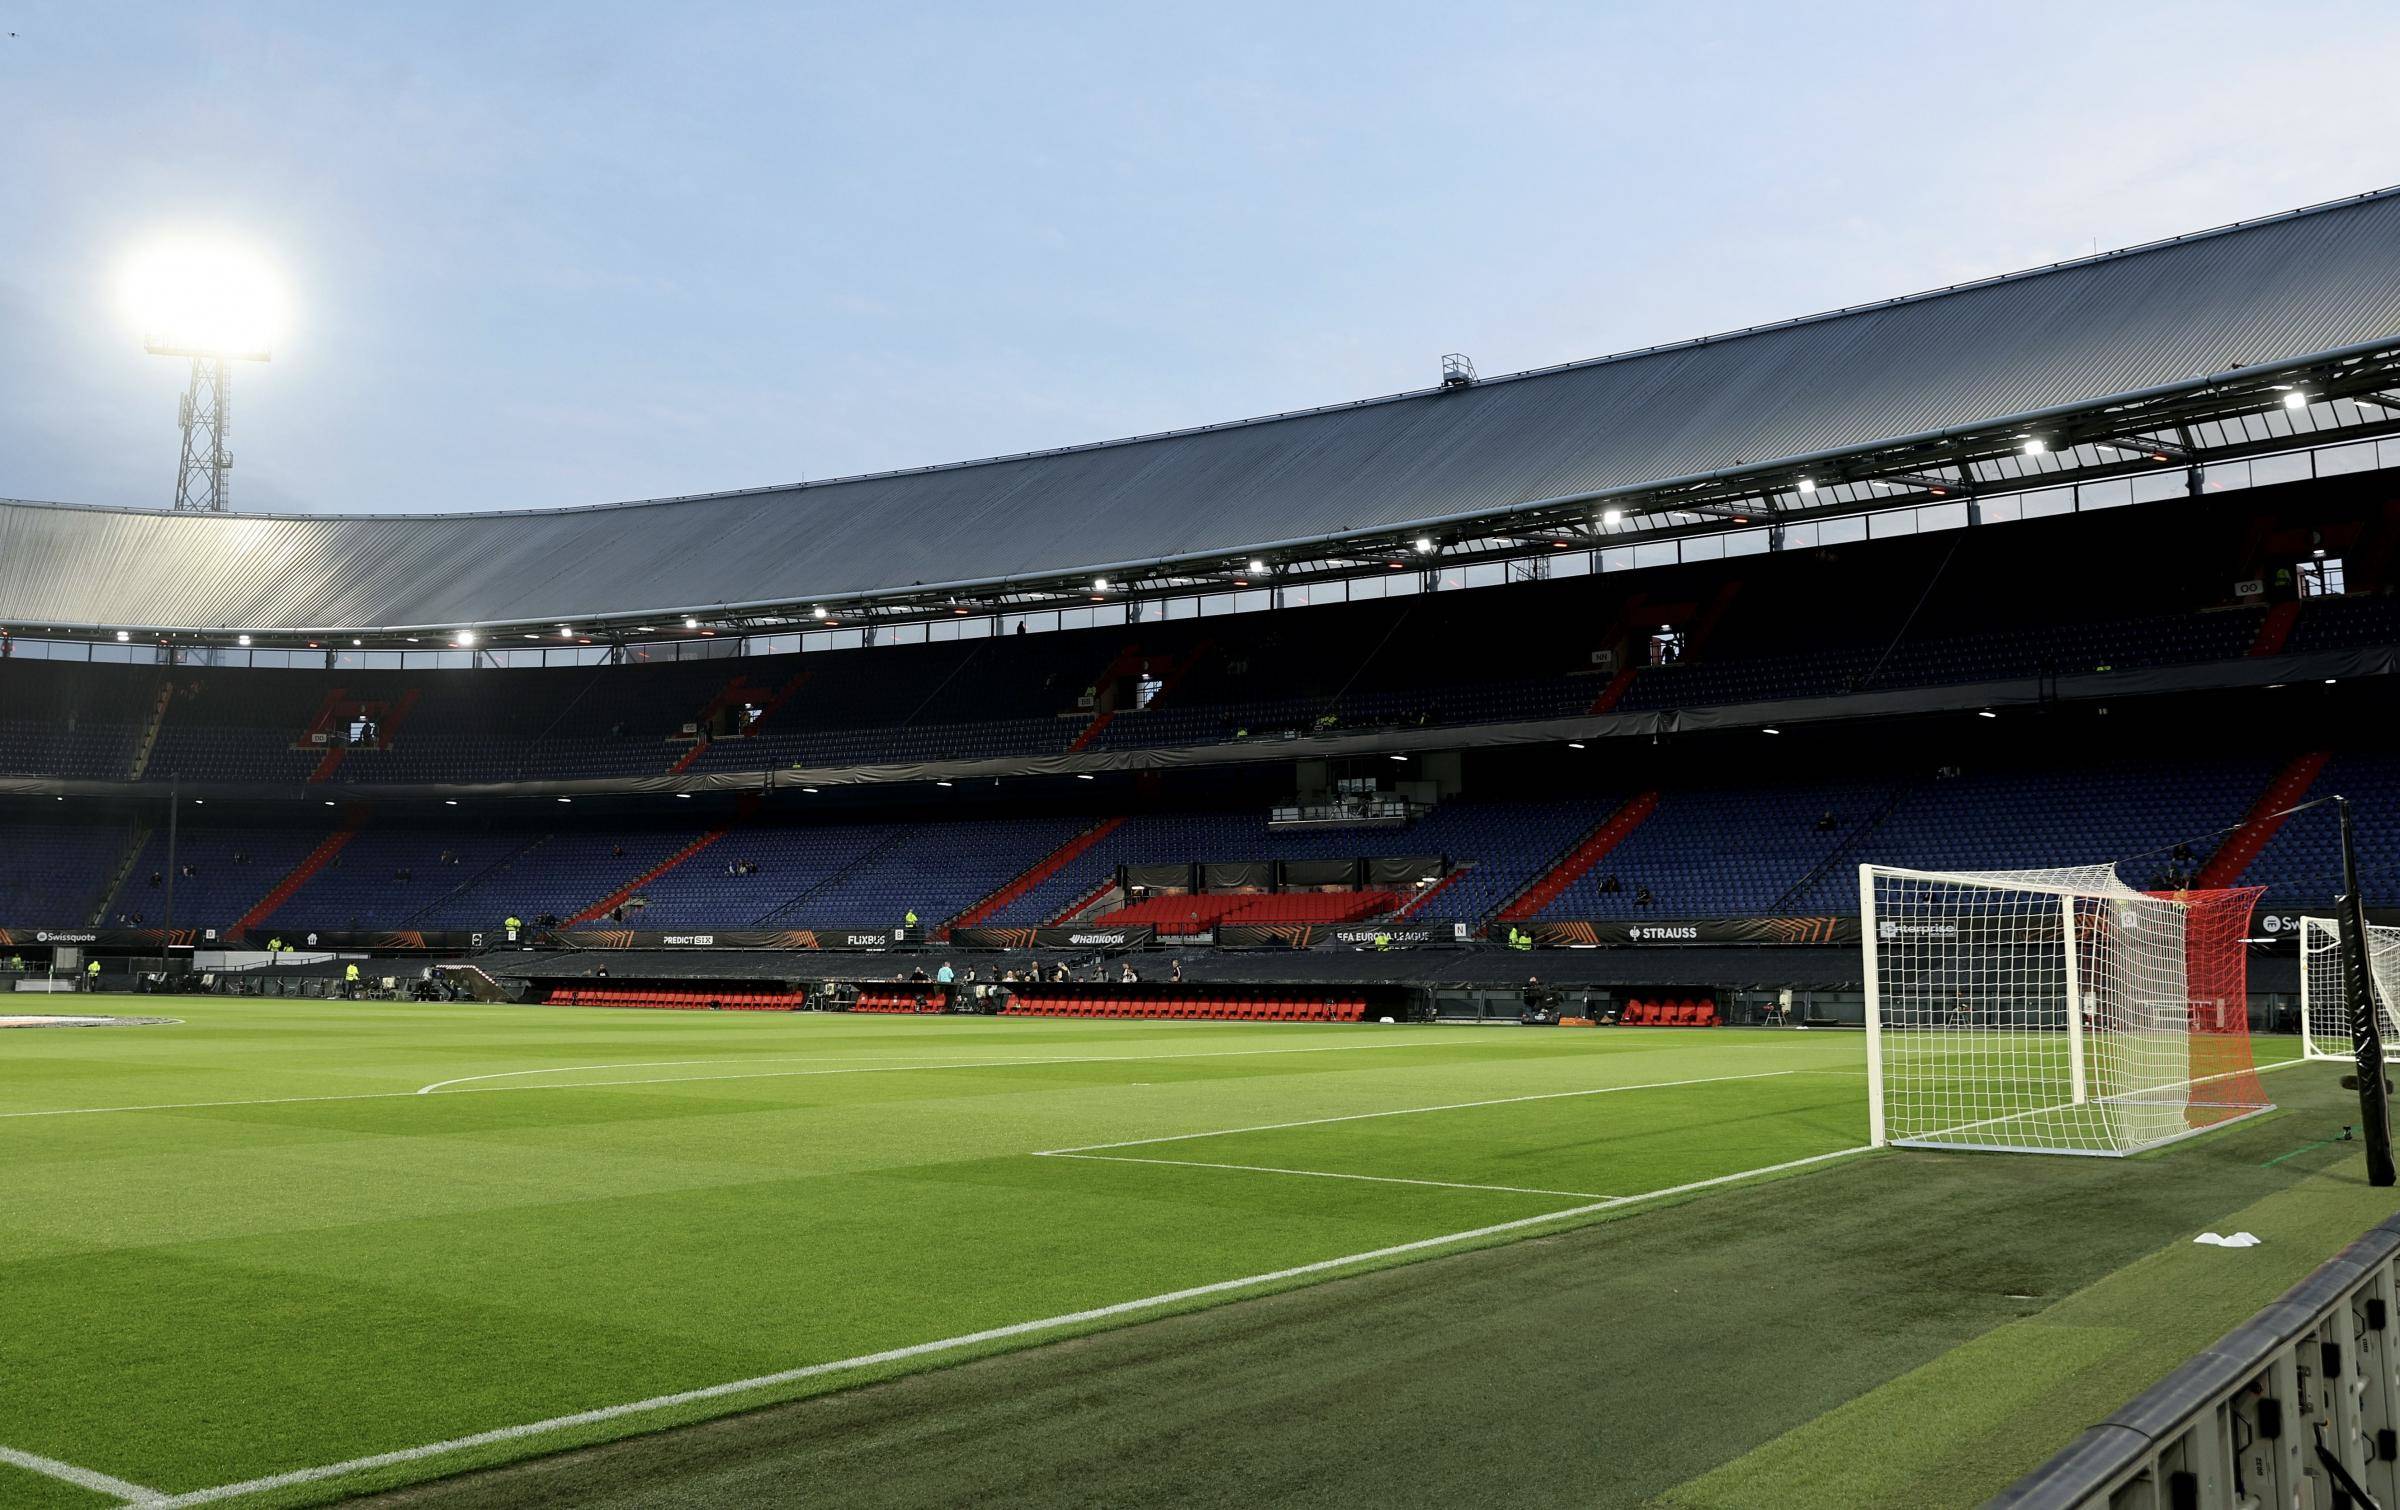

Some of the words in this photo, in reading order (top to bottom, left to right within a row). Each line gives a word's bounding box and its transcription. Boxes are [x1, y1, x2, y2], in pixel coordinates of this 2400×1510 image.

[48, 932, 96, 943] Swissquote
[1642, 927, 1697, 939] STRAUSS
[663, 936, 694, 944] PREDICT
[695, 935, 713, 945] SIX
